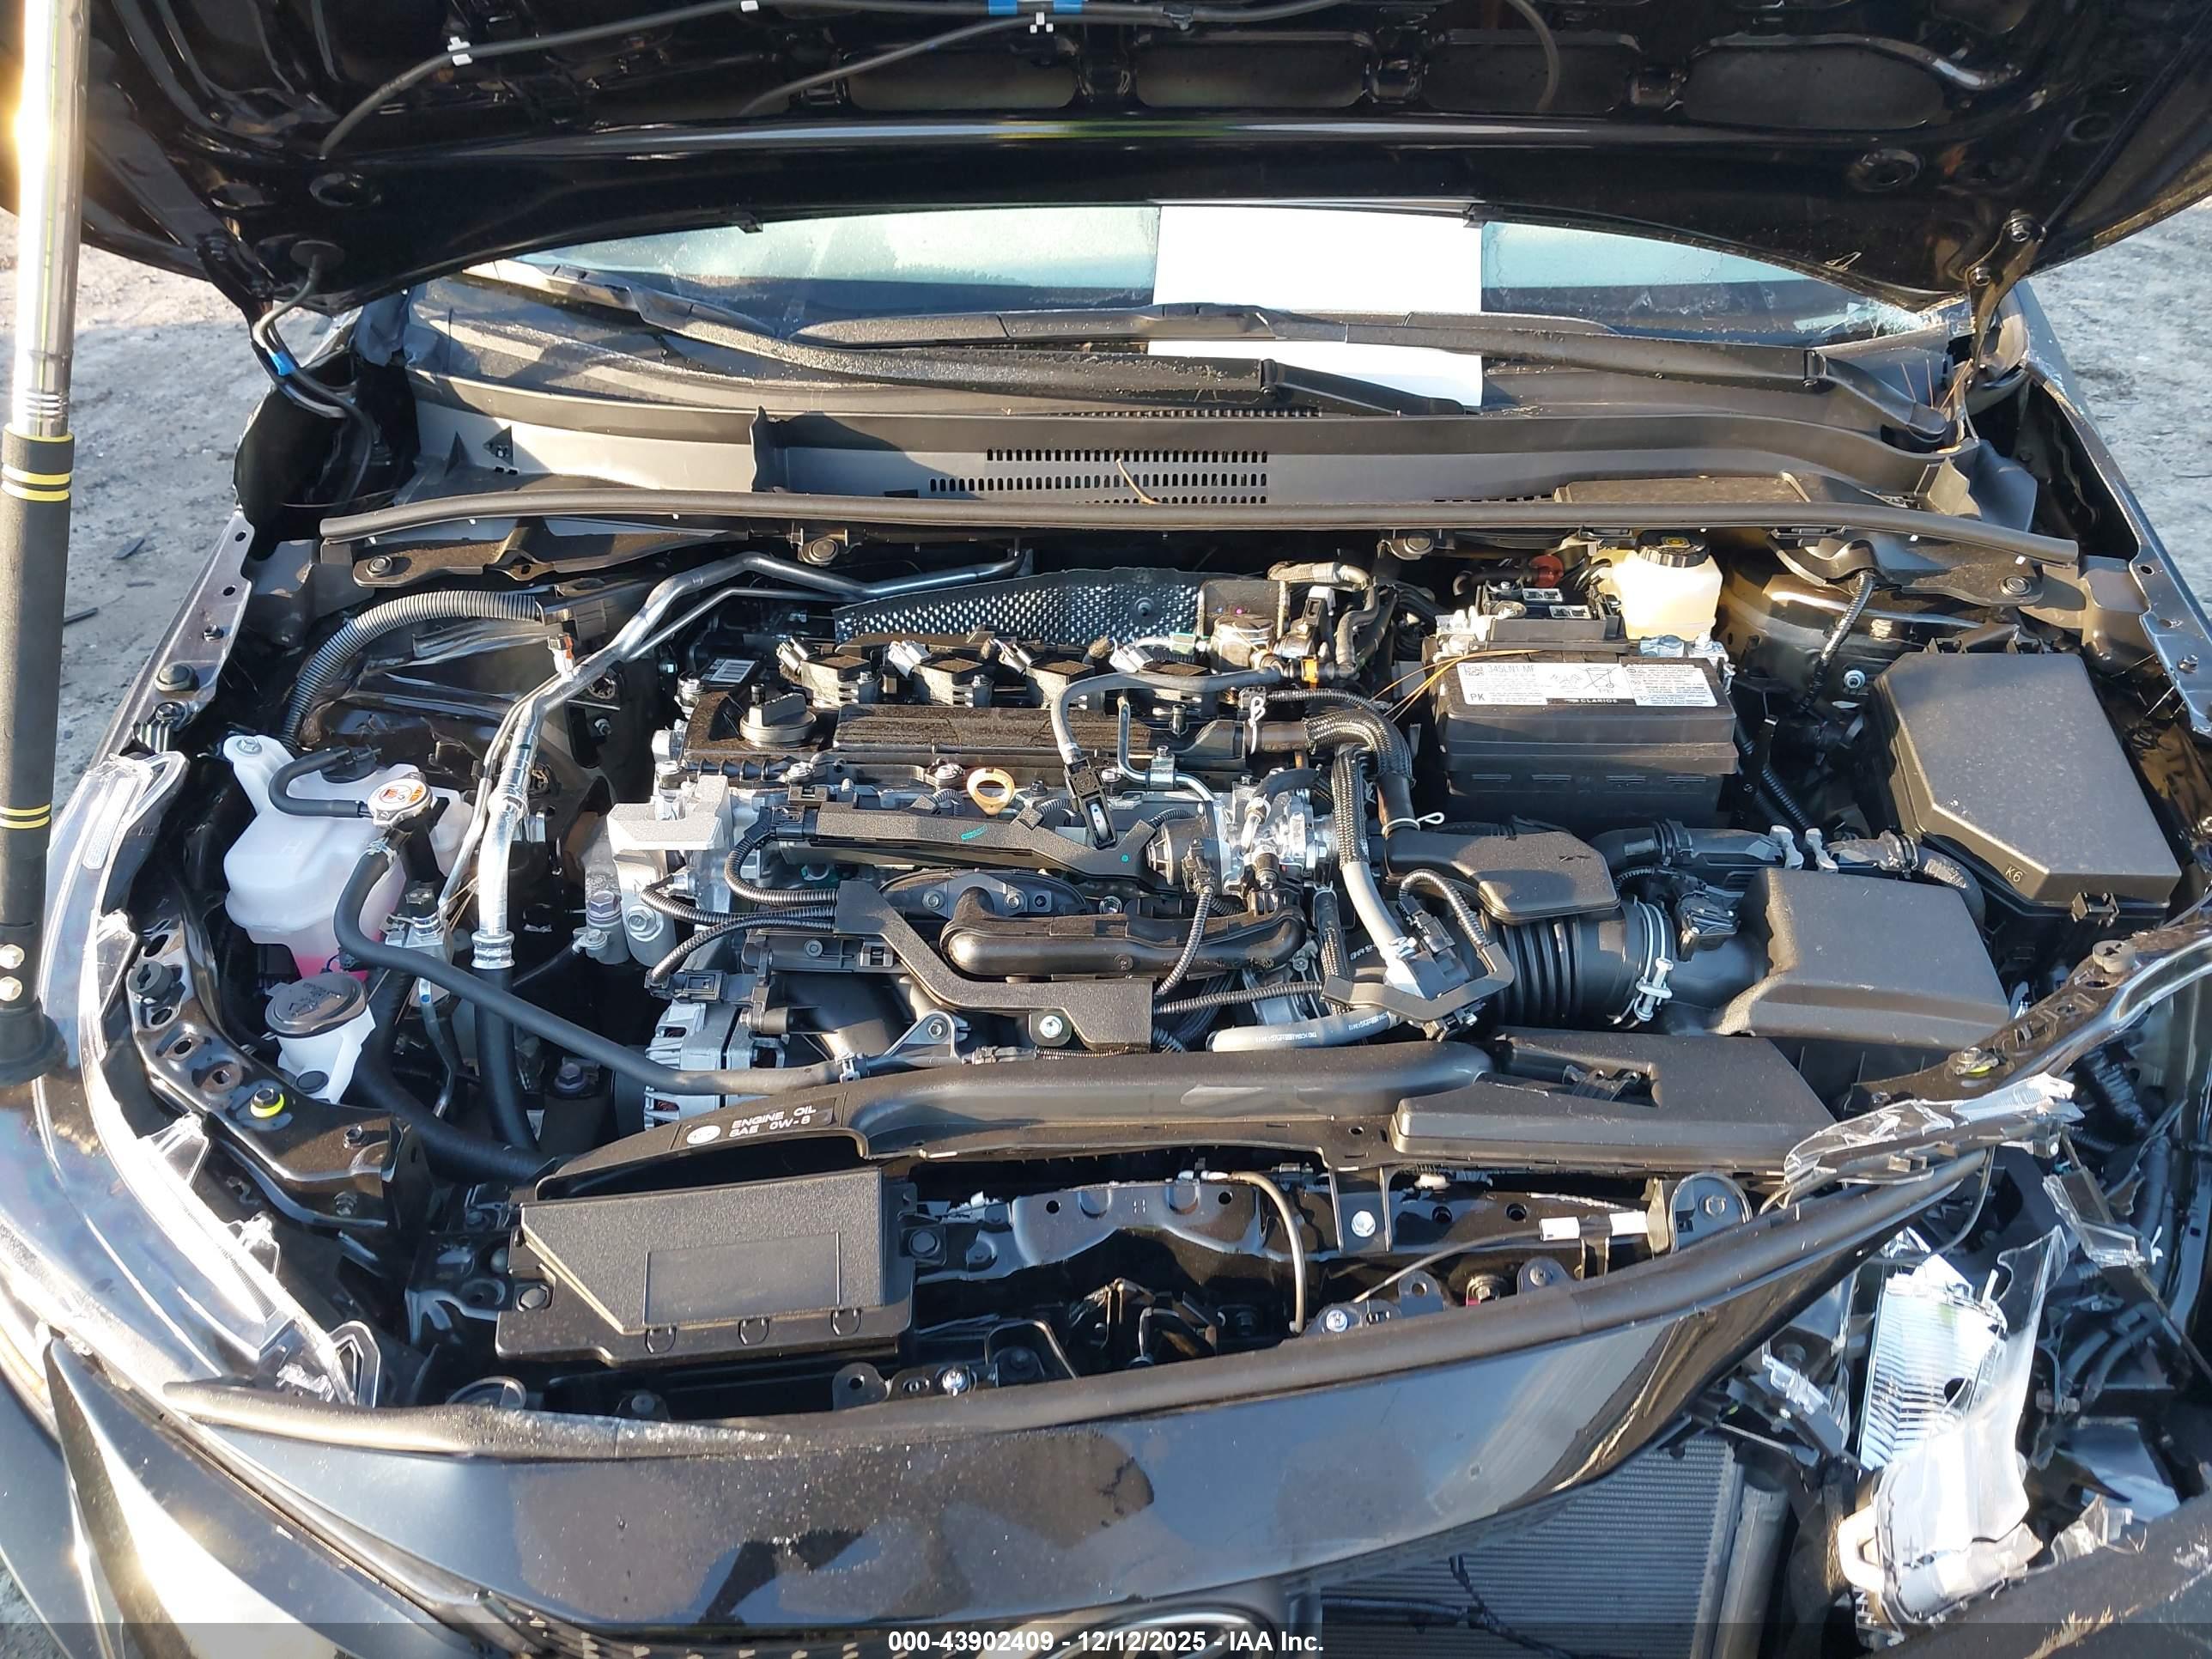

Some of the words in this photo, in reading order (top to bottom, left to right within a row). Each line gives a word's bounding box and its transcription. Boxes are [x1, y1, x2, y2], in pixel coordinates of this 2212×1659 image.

[1469, 693, 1486, 702] PK
[2005, 866, 2023, 883] K6
[732, 1111, 785, 1128] ENGINE
[793, 1105, 817, 1116] OIL
[729, 1125, 759, 1137] SAE
